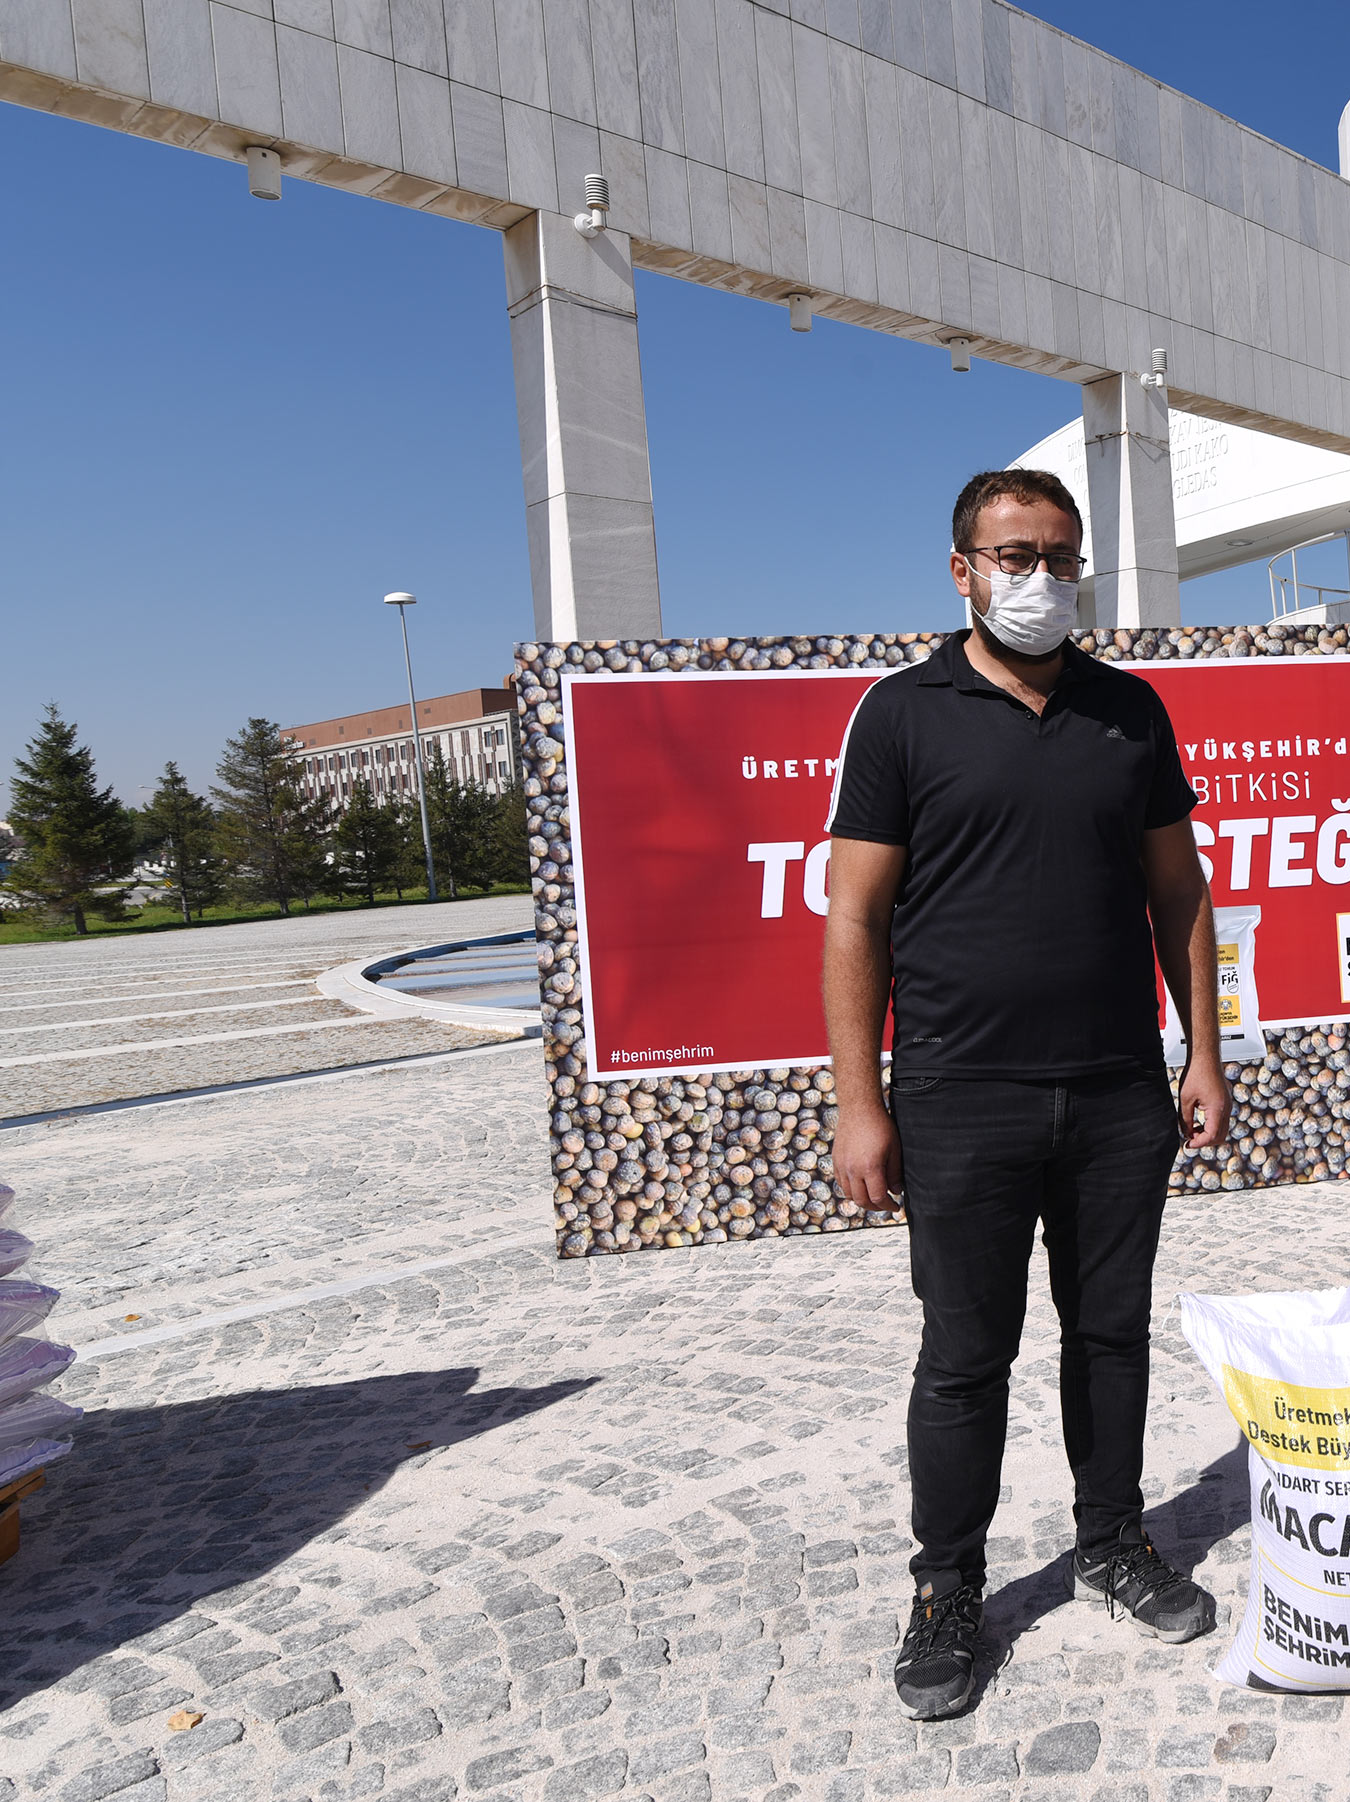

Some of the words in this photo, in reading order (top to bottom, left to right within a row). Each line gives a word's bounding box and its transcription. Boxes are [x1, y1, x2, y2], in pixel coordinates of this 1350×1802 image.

[742, 756, 840, 779] ÜRETM
[747, 839, 832, 919] TO
[610, 1043, 715, 1066] #benimşehrim
[1247, 1419, 1313, 1455] Destek
[1272, 1471, 1320, 1496] NDART
